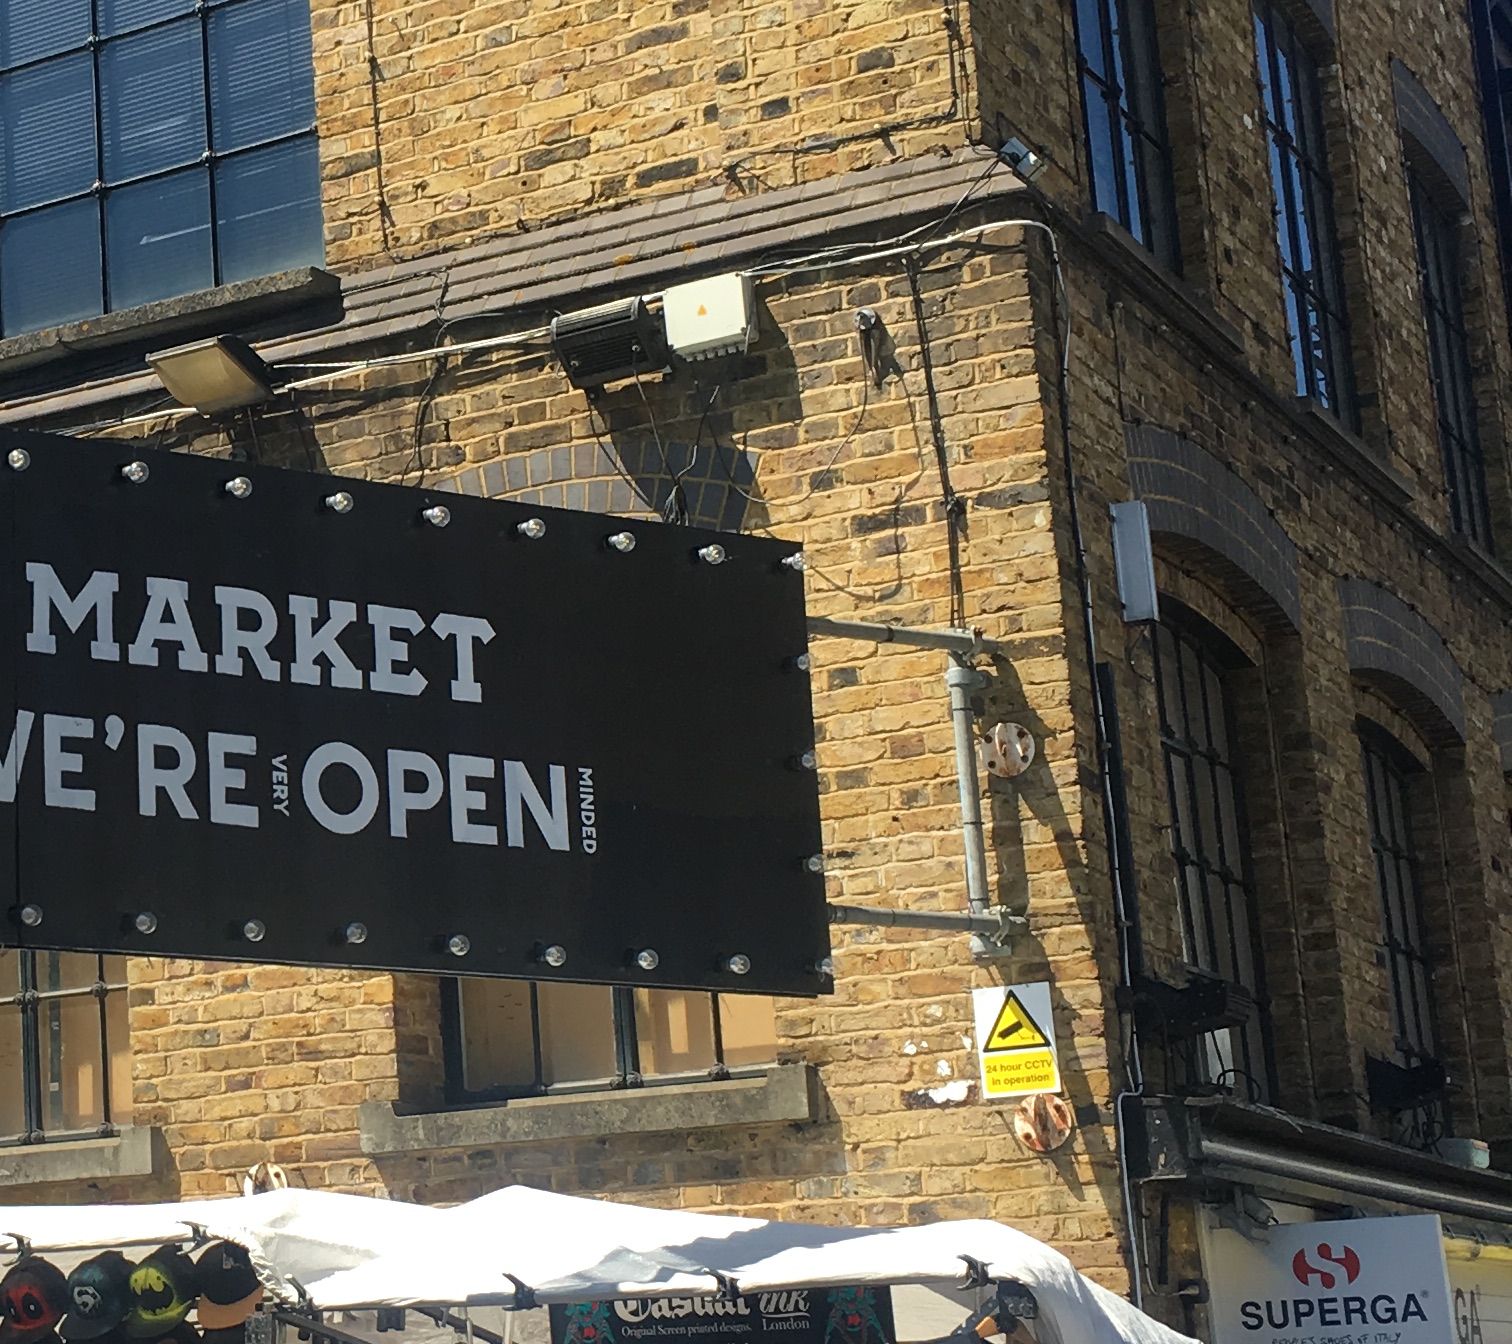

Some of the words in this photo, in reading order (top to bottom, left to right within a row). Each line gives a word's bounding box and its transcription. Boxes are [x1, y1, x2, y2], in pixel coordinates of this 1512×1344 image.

[25, 561, 496, 703] MARKET
[269, 753, 290, 817] VERY
[301, 741, 570, 851] OPEN
[577, 767, 598, 855] MINDED
[986, 1064, 998, 1074] 24
[1000, 1063, 1022, 1072] hour
[1024, 1059, 1053, 1070] CCTV
[1003, 1073, 1050, 1086] operation
[1240, 1292, 1429, 1331] SUPERGA
[621, 1325, 656, 1339] Original
[657, 1324, 686, 1336] Screen
[687, 1322, 719, 1337] printed
[762, 1318, 810, 1331] London
